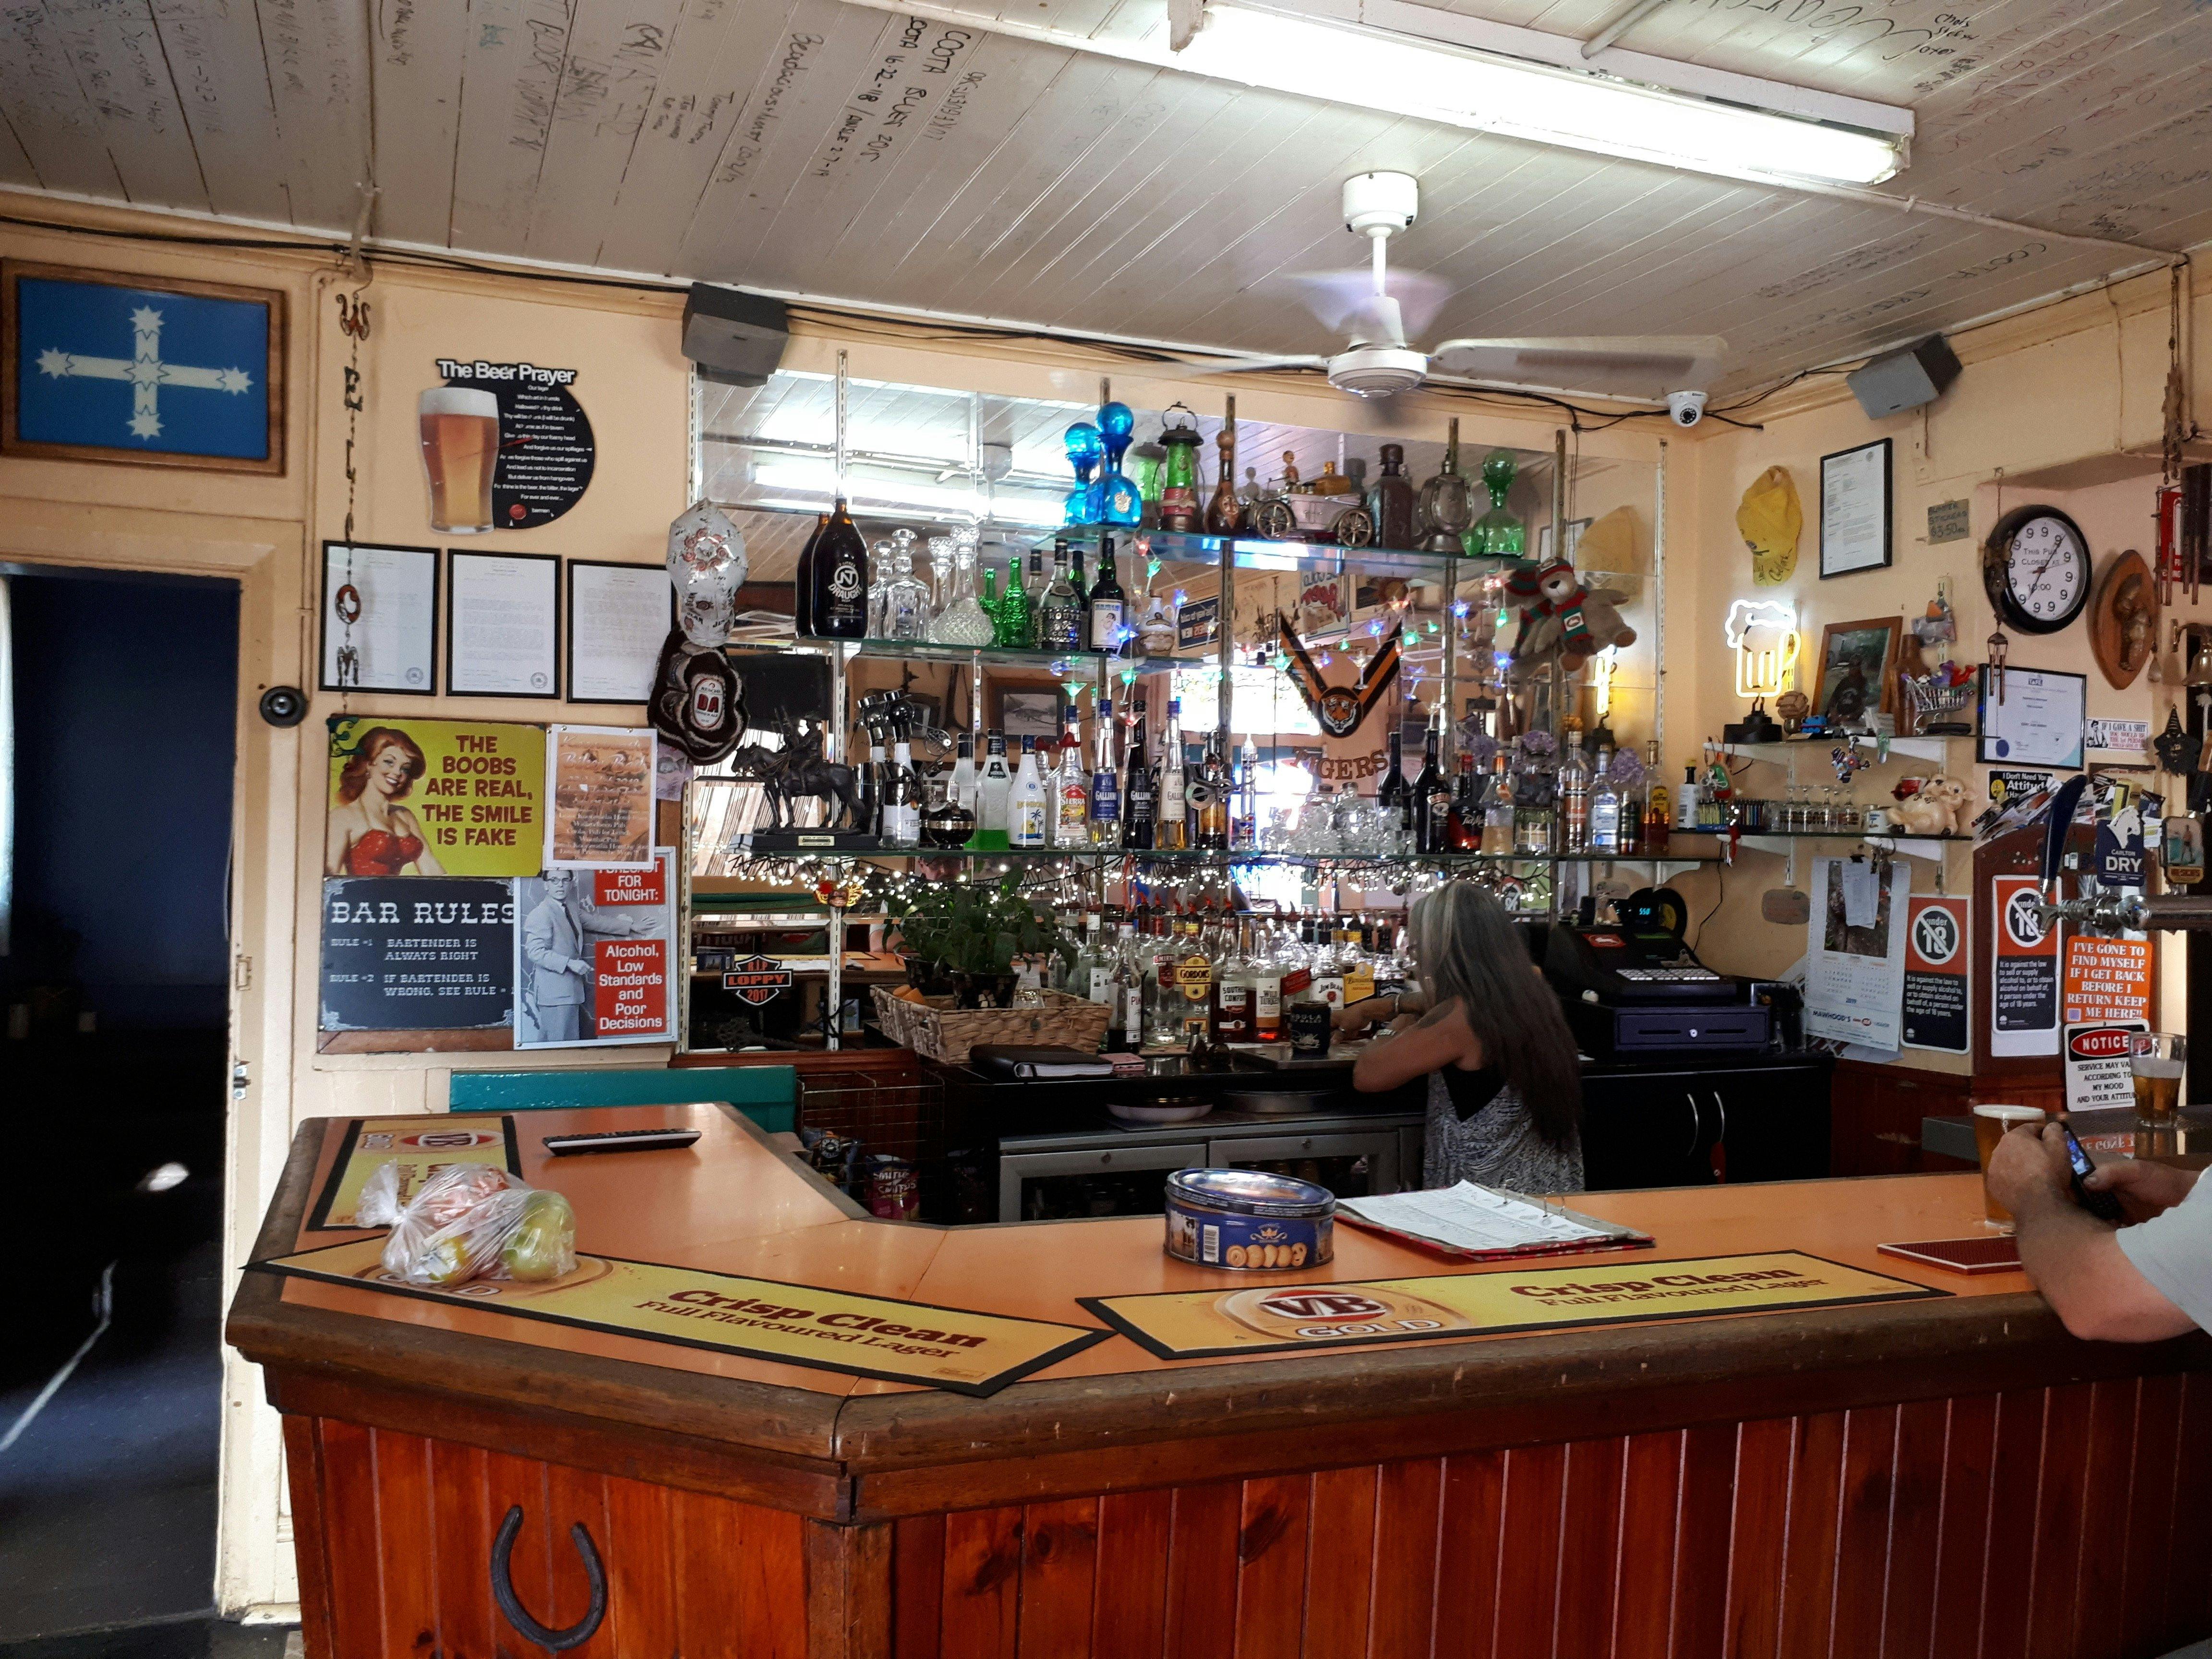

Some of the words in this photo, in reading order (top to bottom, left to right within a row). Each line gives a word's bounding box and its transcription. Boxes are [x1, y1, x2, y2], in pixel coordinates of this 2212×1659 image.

[438, 361, 472, 379] The
[476, 361, 516, 381] Beer
[519, 364, 576, 386] Prayer
[2026, 527, 2034, 539] 9
[2041, 527, 2048, 537] 9
[2064, 552, 2071, 563] 9
[2066, 572, 2073, 582] 9
[2019, 594, 2026, 605] 9
[2060, 589, 2067, 600] 9
[2033, 602, 2041, 613] 9
[2048, 601, 2056, 612] 9
[456, 734, 498, 753] THE
[443, 755, 517, 775] BOOBS
[425, 778, 468, 796] ARE
[475, 779, 533, 801] REAL,
[2006, 780, 2045, 791] Attitud
[1060, 797, 1085, 805] SIERRA
[421, 804, 464, 822] THE
[470, 805, 533, 823] SMILE
[437, 827, 457, 845] IS
[465, 828, 517, 846] FAKE
[2105, 855, 2143, 873] DRY
[618, 875, 642, 888] FOR
[604, 889, 659, 902] TONIGHT:
[2018, 899, 2035, 908] unde
[331, 902, 400, 924] BAR
[414, 902, 514, 924] RULES
[386, 938, 461, 948] BARTENDER
[465, 938, 477, 948] IS
[1922, 926, 1948, 954] 18
[384, 951, 436, 961] ALWAYS
[440, 951, 479, 961] RIGHT
[605, 944, 659, 958] Alcohol,
[2073, 942, 2094, 953] I'VE
[2096, 943, 2127, 955] GONE
[2129, 946, 2145, 957] TO
[617, 960, 645, 973] Low
[2072, 954, 2098, 966] FIND
[2100, 956, 2146, 969] MYSELF
[384, 974, 397, 984] IF
[400, 974, 474, 984] BARTENDER
[478, 974, 490, 983] IS
[599, 973, 662, 986] Standards
[727, 974, 786, 986] LOPPY
[2070, 967, 2081, 978] IF
[2083, 968, 2089, 978] I
[2091, 969, 2112, 980] GET
[2115, 970, 2145, 982] BACK
[438, 986, 461, 996] SEE
[464, 986, 497, 995] RULE
[618, 987, 644, 1000] and
[2081, 981, 2124, 993] BEFORE
[2127, 984, 2132, 994] I
[2067, 993, 2112, 1005] RETURN
[2115, 995, 2147, 1007] KEEP
[615, 1003, 647, 1016] Poor
[2085, 1007, 2102, 1018] ME
[599, 1016, 663, 1030] Decisions
[2082, 1035, 2129, 1051] NOTICE
[2077, 1062, 2104, 1071] SERVICE
[2083, 1072, 2121, 1082] ACCORDING
[2104, 1082, 2124, 1090] MOOD
[2077, 1095, 2090, 1104] AND
[2091, 1094, 2109, 1102] YOUR
[2111, 1092, 2137, 1100] ATTITU
[1510, 1283, 1655, 1297] Crisp
[1651, 1269, 1804, 1287] Clean
[1535, 1296, 1605, 1306] Full
[1598, 1283, 1755, 1302] Flavoured
[1746, 1278, 1829, 1291] Lager
[1259, 1294, 1386, 1318] VB
[668, 1289, 816, 1323] Crisp
[816, 1311, 988, 1349] Clean
[632, 1300, 706, 1321] Full
[707, 1309, 864, 1343] Flavoured
[863, 1333, 961, 1359] Lager
[1295, 1318, 1443, 1338] GOLD
